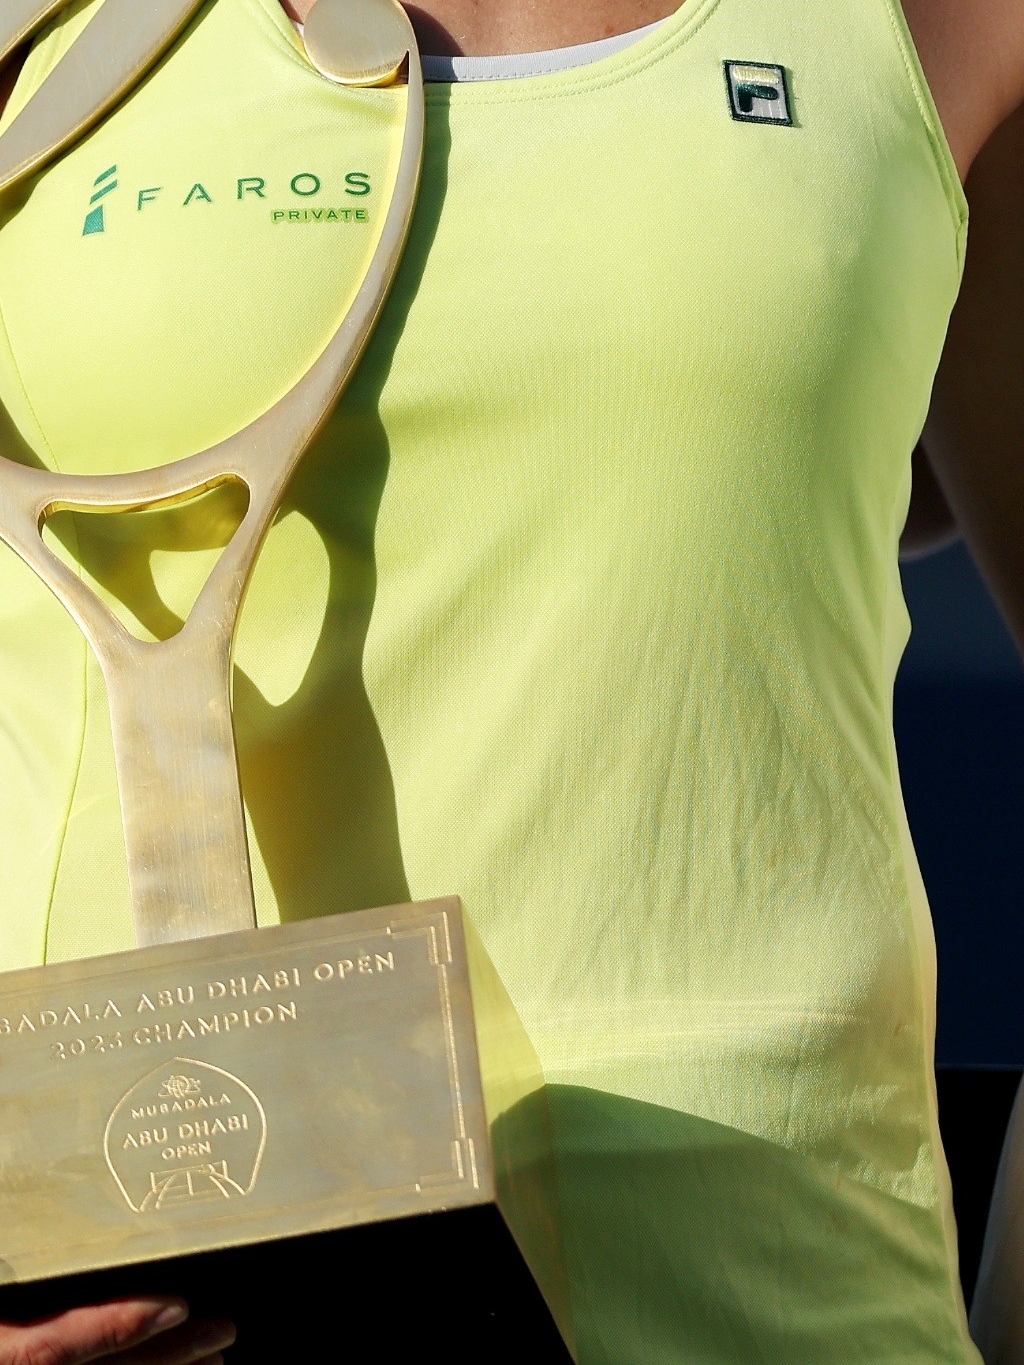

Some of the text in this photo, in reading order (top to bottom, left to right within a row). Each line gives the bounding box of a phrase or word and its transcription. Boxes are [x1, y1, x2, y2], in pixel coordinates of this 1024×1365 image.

[136, 172, 371, 211] FAROS
[273, 209, 367, 222] PRIVATE
[136, 985, 195, 1013] ABU
[207, 967, 301, 1000] DHABI
[312, 950, 396, 982] OPEN
[51, 1000, 298, 1060] 2023 CHAMPION
[130, 1092, 232, 1120] MUBADALA
[122, 1113, 250, 1151] ABU DHABI
[161, 1140, 213, 1161] OPEN
